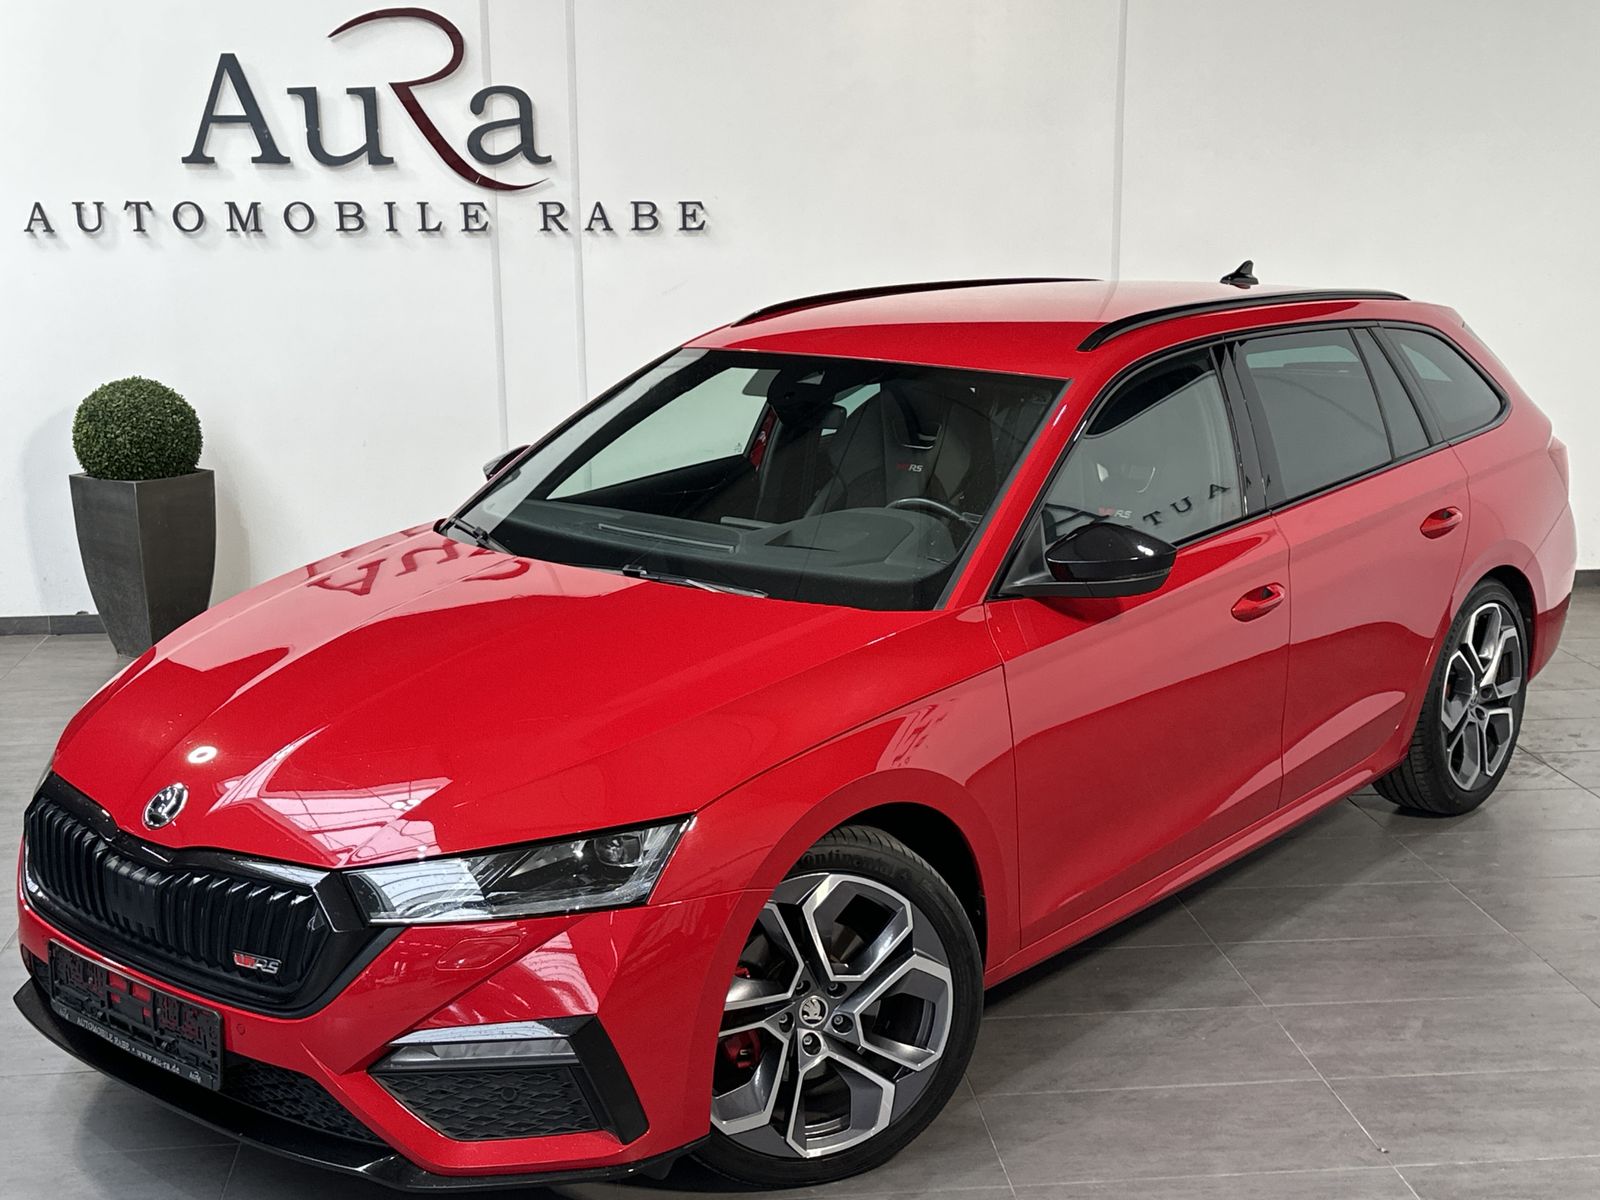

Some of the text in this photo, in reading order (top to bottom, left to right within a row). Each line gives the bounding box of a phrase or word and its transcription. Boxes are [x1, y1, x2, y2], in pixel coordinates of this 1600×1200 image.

[24, 201, 707, 235] AUTOMOBILE RABE
[77, 1016, 113, 1044] AUTOMOBILE
